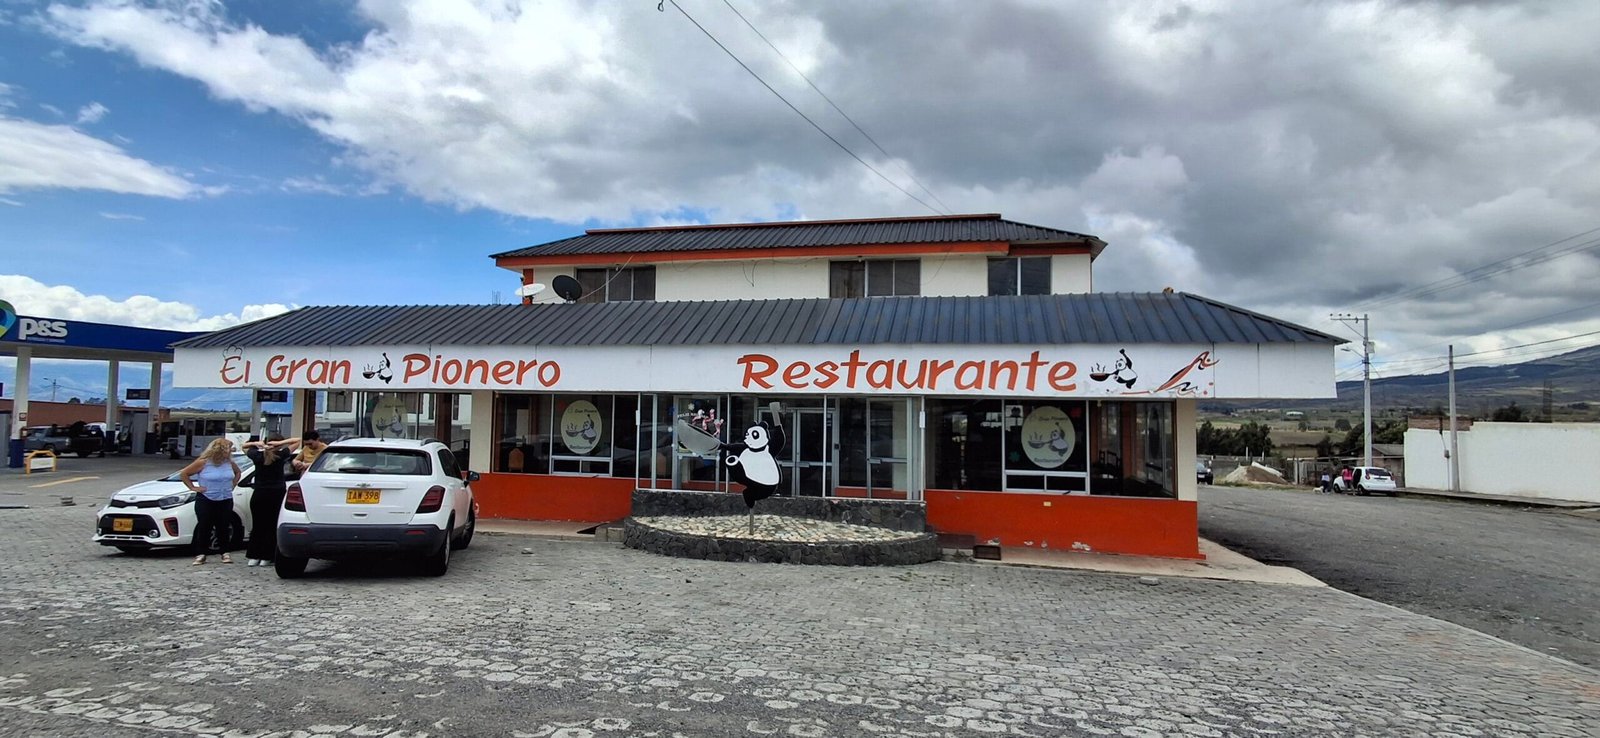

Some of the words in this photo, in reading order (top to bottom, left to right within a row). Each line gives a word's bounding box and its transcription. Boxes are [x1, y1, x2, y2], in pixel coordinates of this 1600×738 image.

[266, 355, 352, 386] Gran
[402, 353, 562, 388] Pionero
[737, 349, 1078, 392] Restaurante
[364, 491, 379, 500] 398
